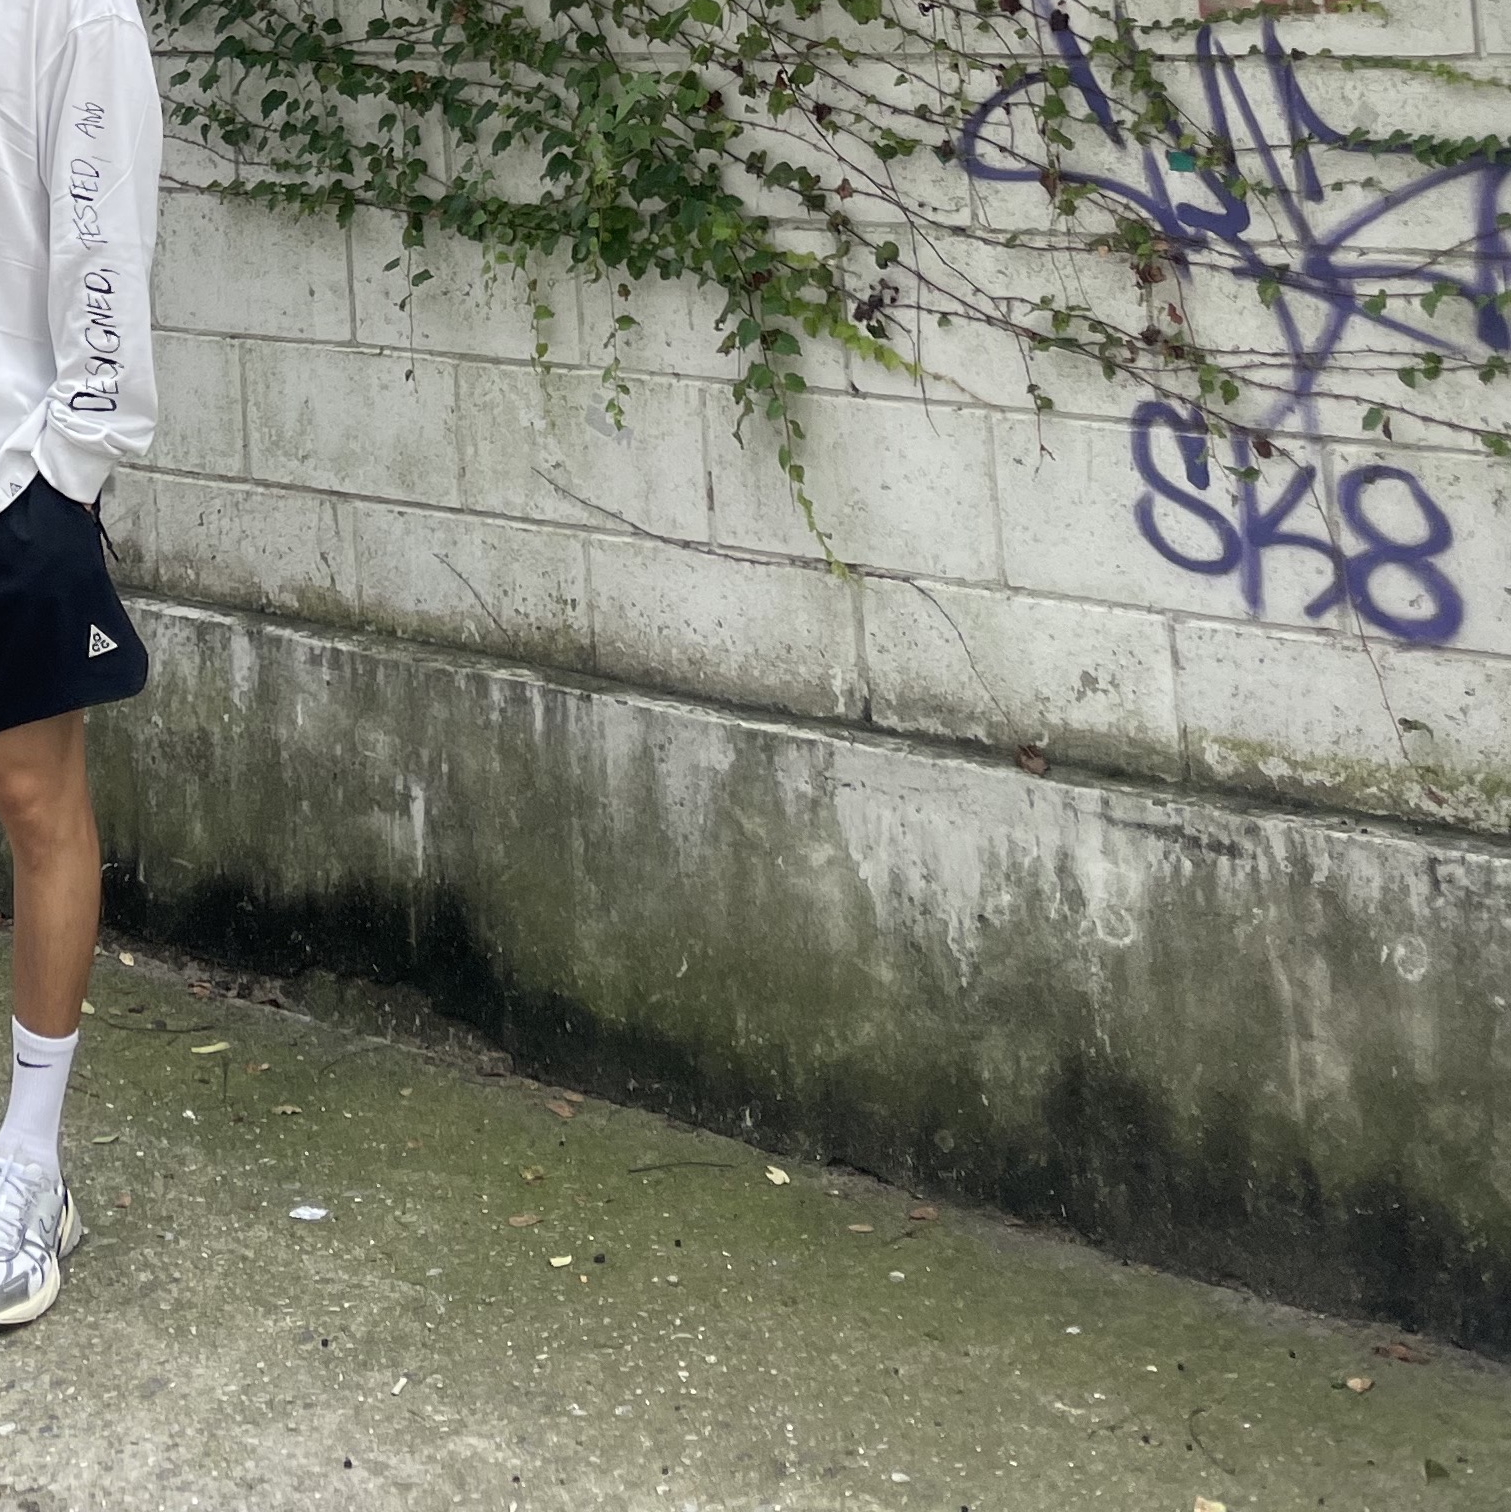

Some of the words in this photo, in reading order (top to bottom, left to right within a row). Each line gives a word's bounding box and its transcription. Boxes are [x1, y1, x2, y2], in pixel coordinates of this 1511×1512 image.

[69, 155, 112, 251] TESTED,
[68, 268, 124, 412] DESIGNED,
[1131, 400, 1464, 643] SK8
